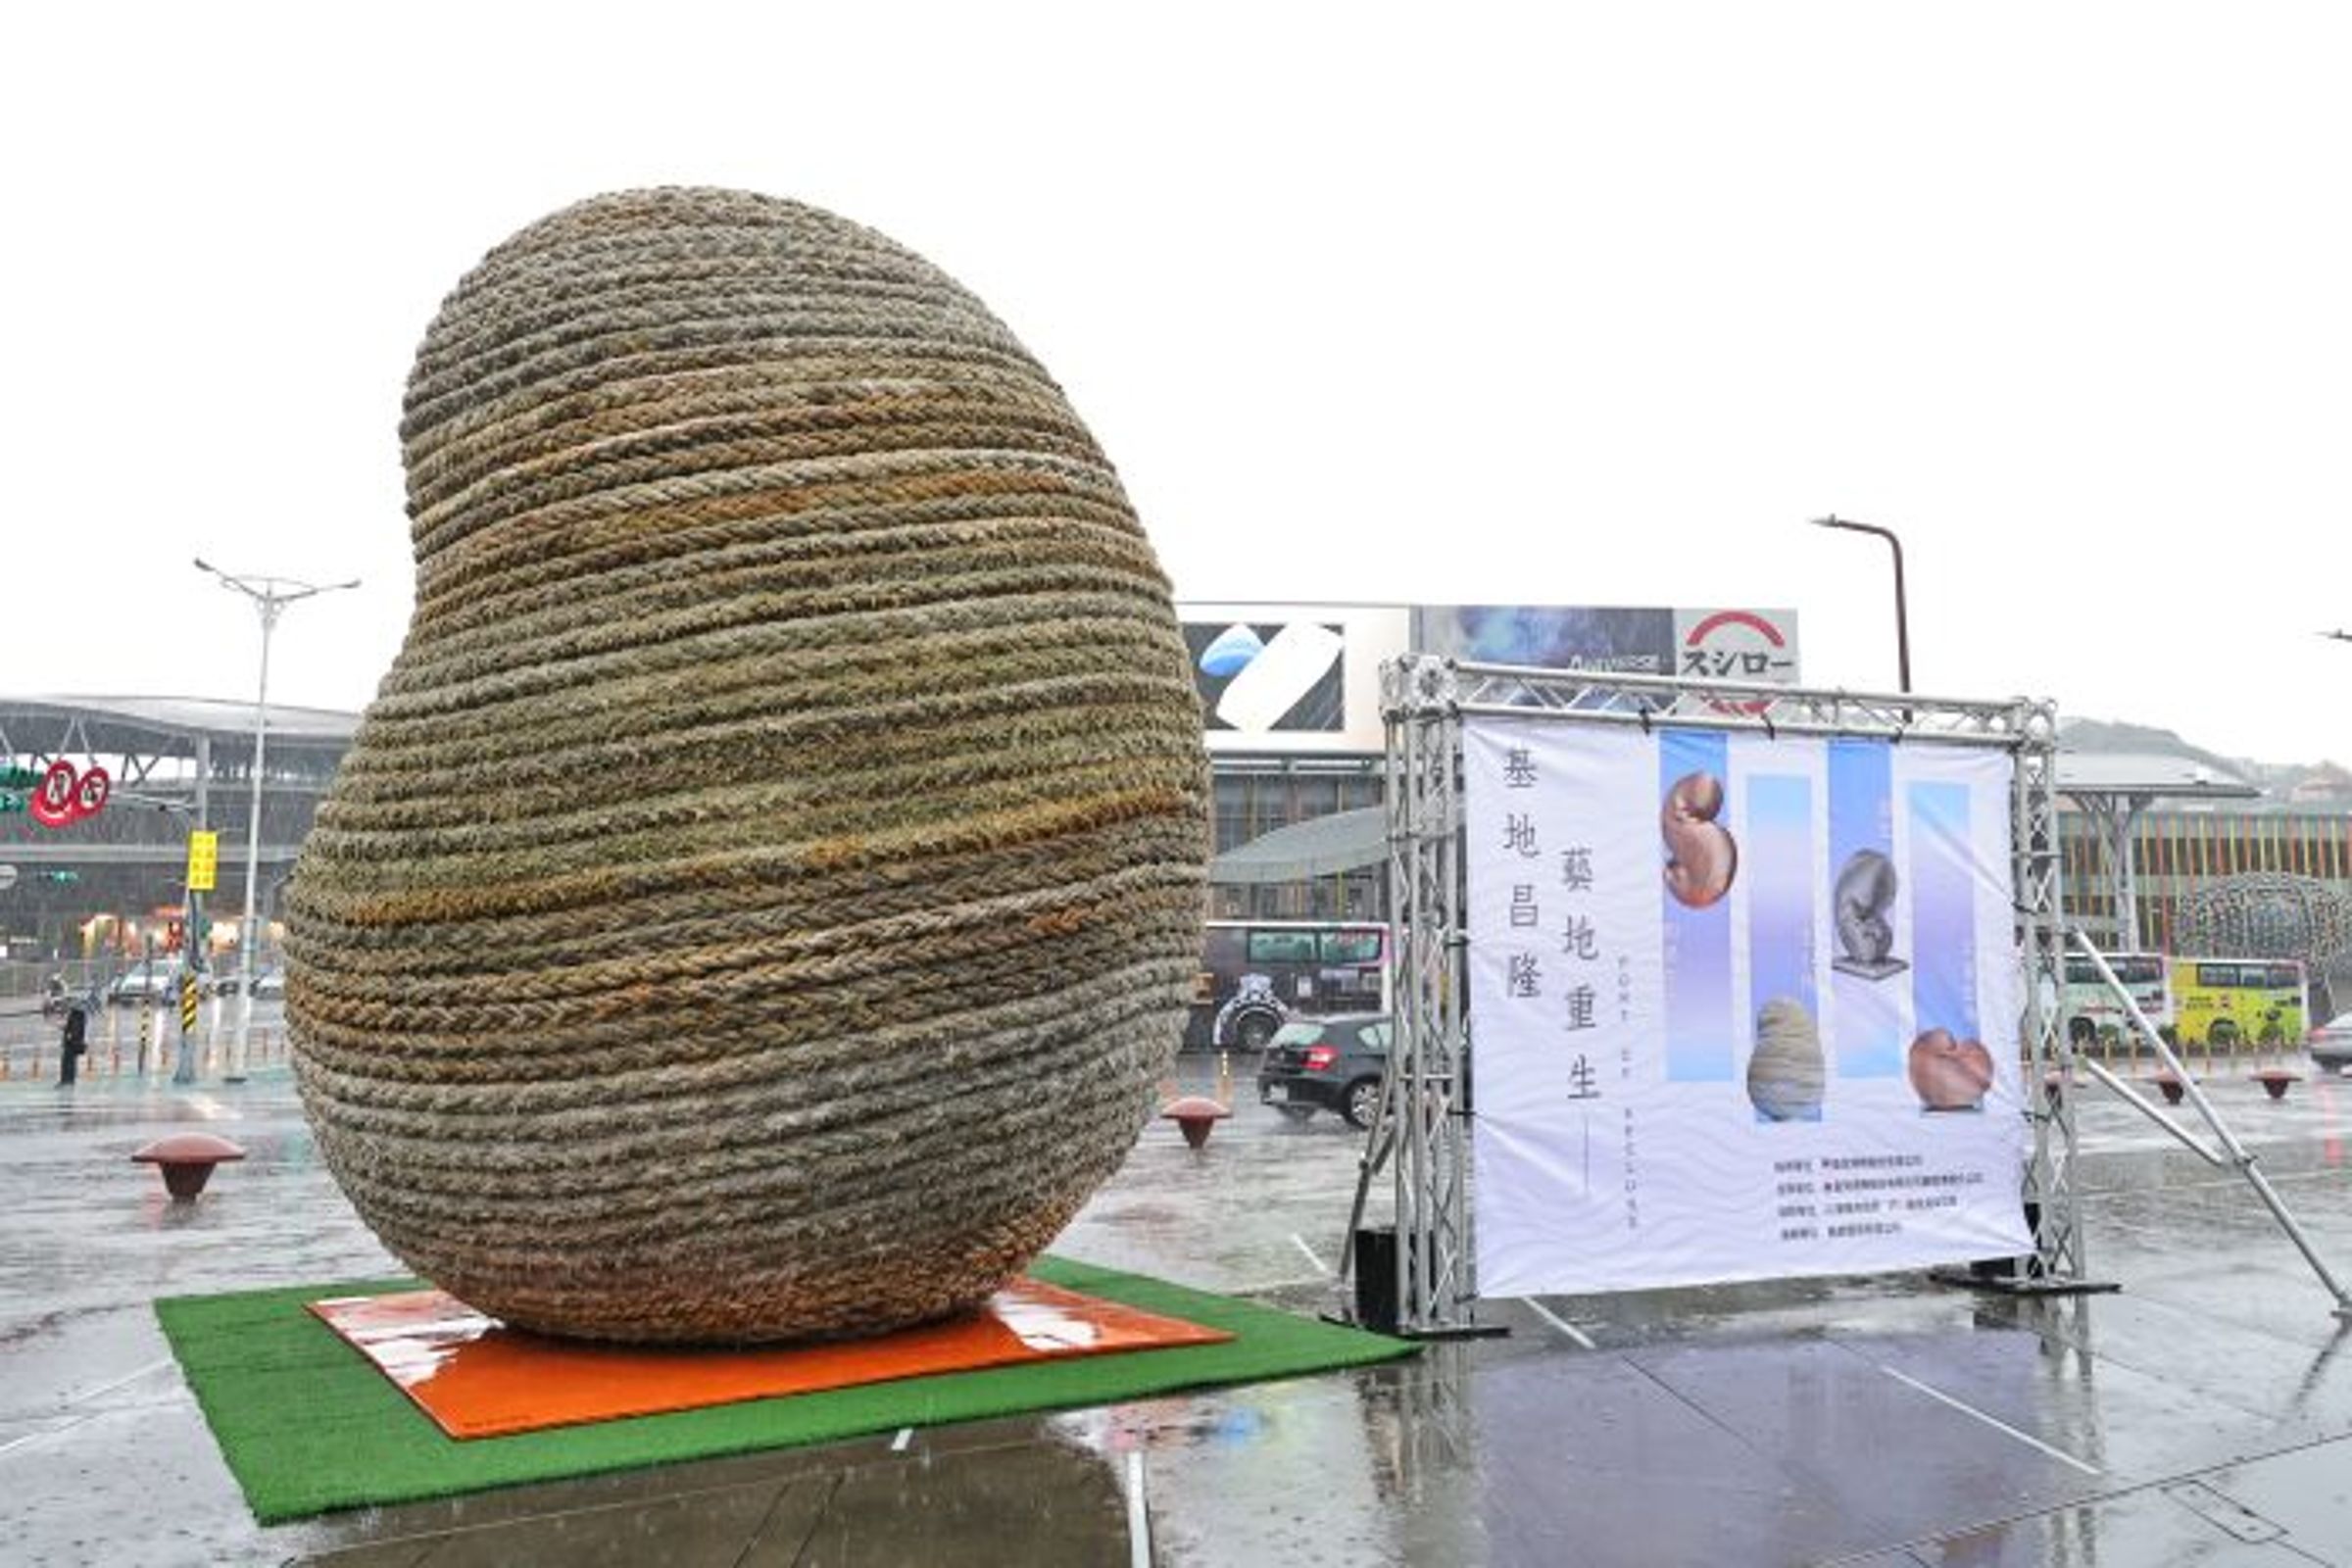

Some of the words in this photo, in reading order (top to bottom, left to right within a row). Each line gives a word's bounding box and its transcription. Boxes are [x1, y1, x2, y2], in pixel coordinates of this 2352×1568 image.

[1681, 650, 1794, 677] スシロー
[1502, 748, 1542, 999] 基地昌隆
[1561, 847, 1602, 1100] 藝地重生
